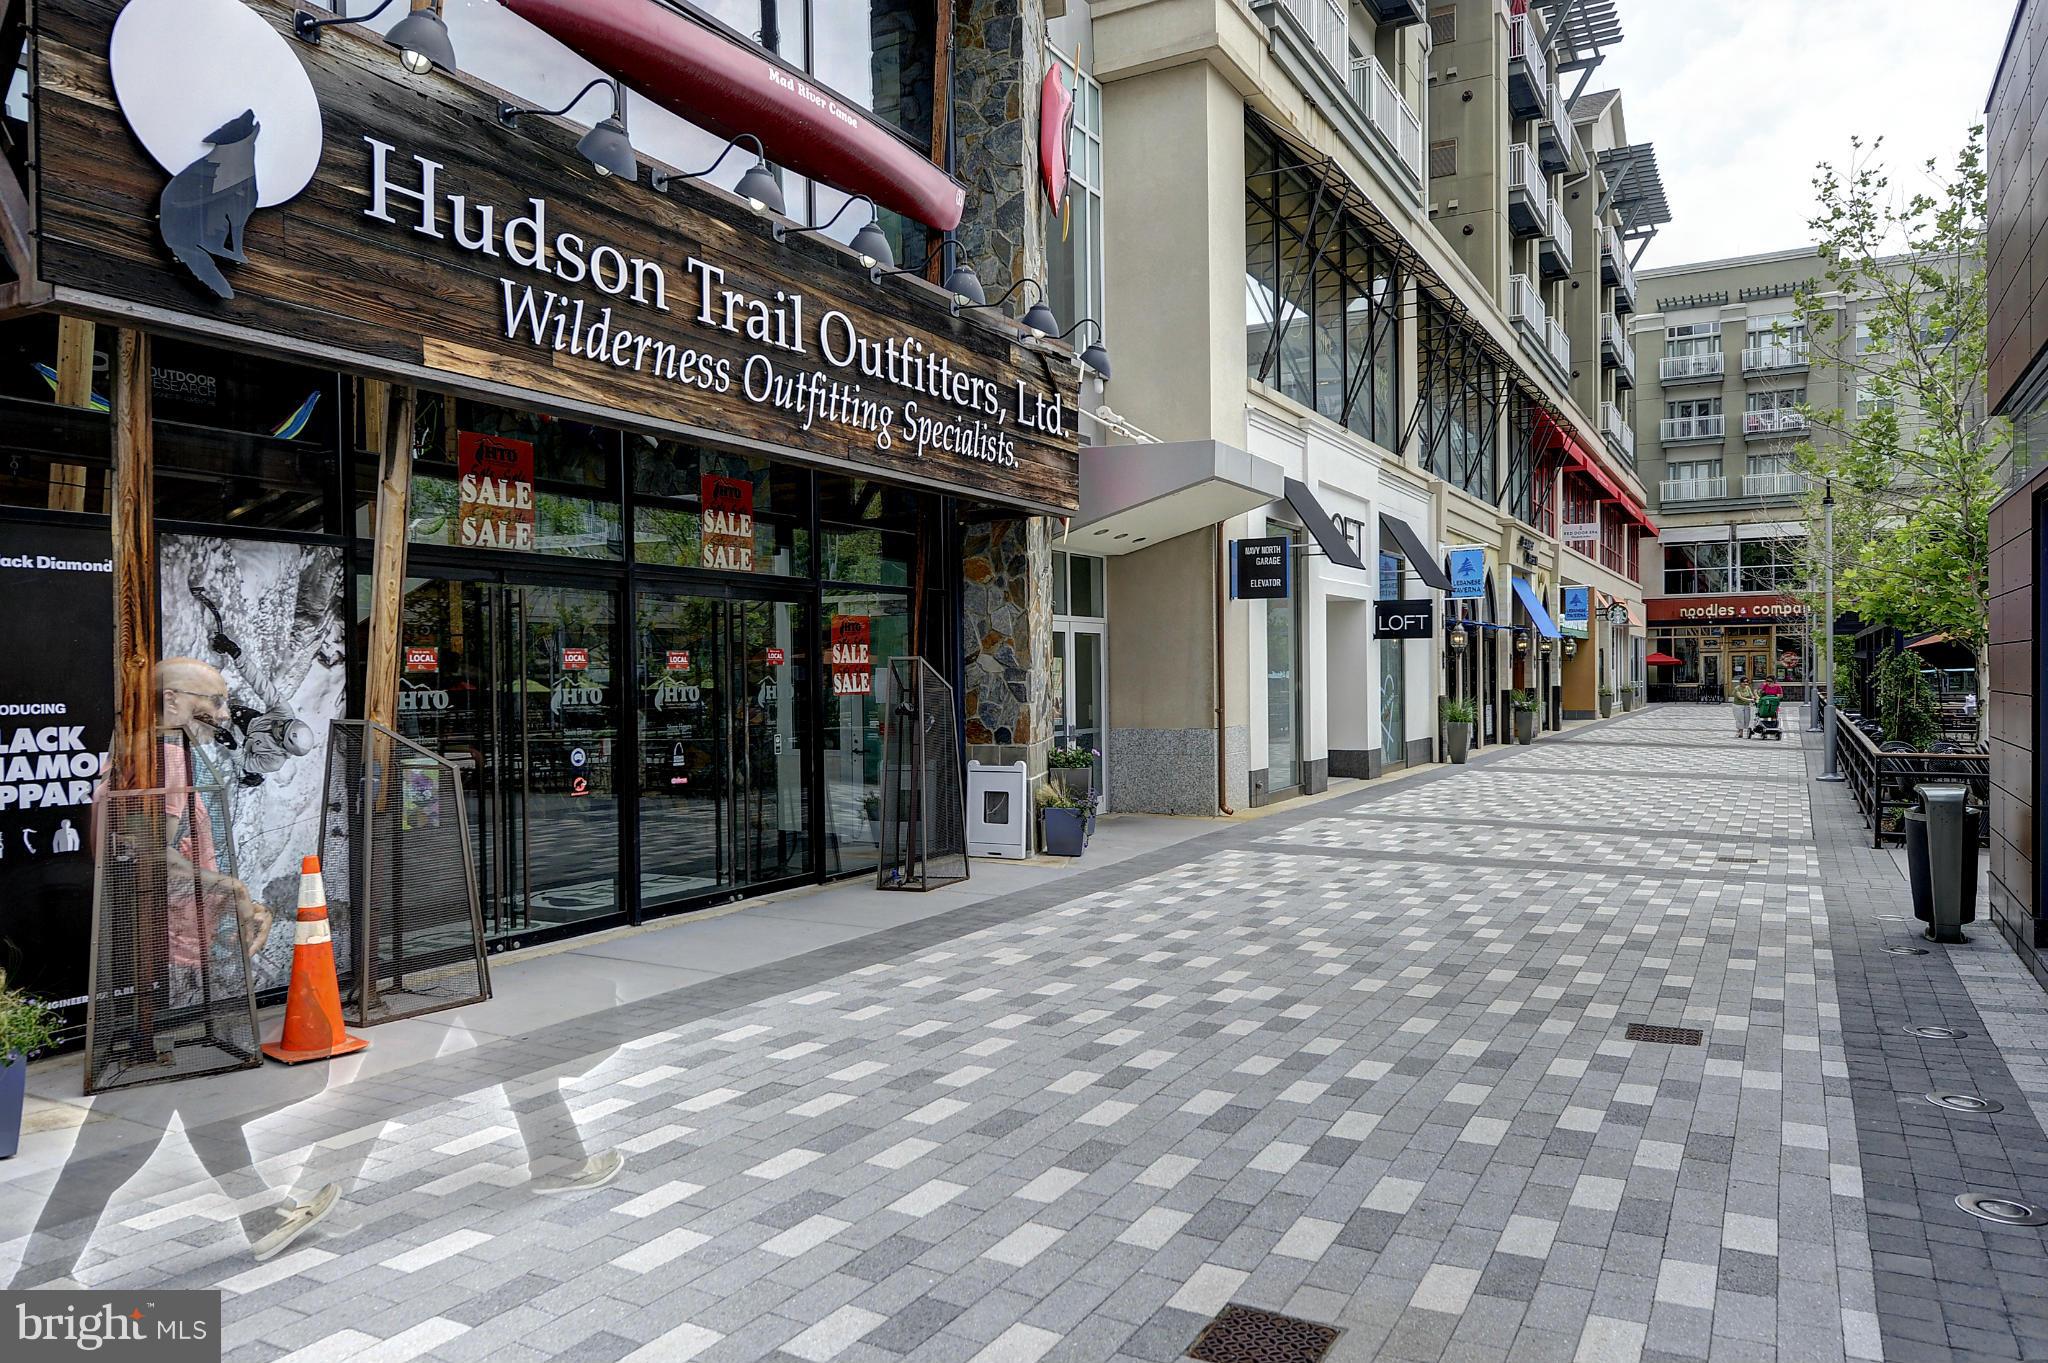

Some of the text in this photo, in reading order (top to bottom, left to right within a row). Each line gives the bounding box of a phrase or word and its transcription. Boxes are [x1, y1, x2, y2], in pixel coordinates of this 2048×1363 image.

[769, 68, 858, 129] Mad River Canoe
[363, 135, 1070, 438] Hudson Trail Outfitters, Ltd.
[499, 277, 1019, 468] Wilderness Outfitting Specialists.
[152, 378, 216, 398] ESEARCH
[462, 473, 532, 510] SALE
[462, 516, 532, 551] SALE
[703, 509, 752, 538] SALE
[1331, 513, 1365, 562] OFT
[703, 543, 752, 571] SALE
[1245, 545, 1281, 555] NAVY NORTH
[0, 555, 113, 572] ack Diamond
[1255, 556, 1281, 566] GARAGE
[1250, 578, 1282, 588] ELEVATOR
[1679, 603, 1735, 618] noodles
[1752, 603, 1811, 618] compan
[1378, 614, 1429, 631] LOFT
[409, 654, 436, 663] LOCAL
[564, 654, 586, 662] LOCAL
[832, 643, 869, 664] SALE
[833, 672, 870, 693] SALE
[397, 690, 450, 710] HTO
[562, 688, 603, 705] HTO
[665, 686, 700, 702] HTO
[0, 703, 66, 716] ODUCING
[0, 725, 86, 754] LACK
[0, 779, 102, 811] PPAR
[47, 995, 89, 1010] GINEER
